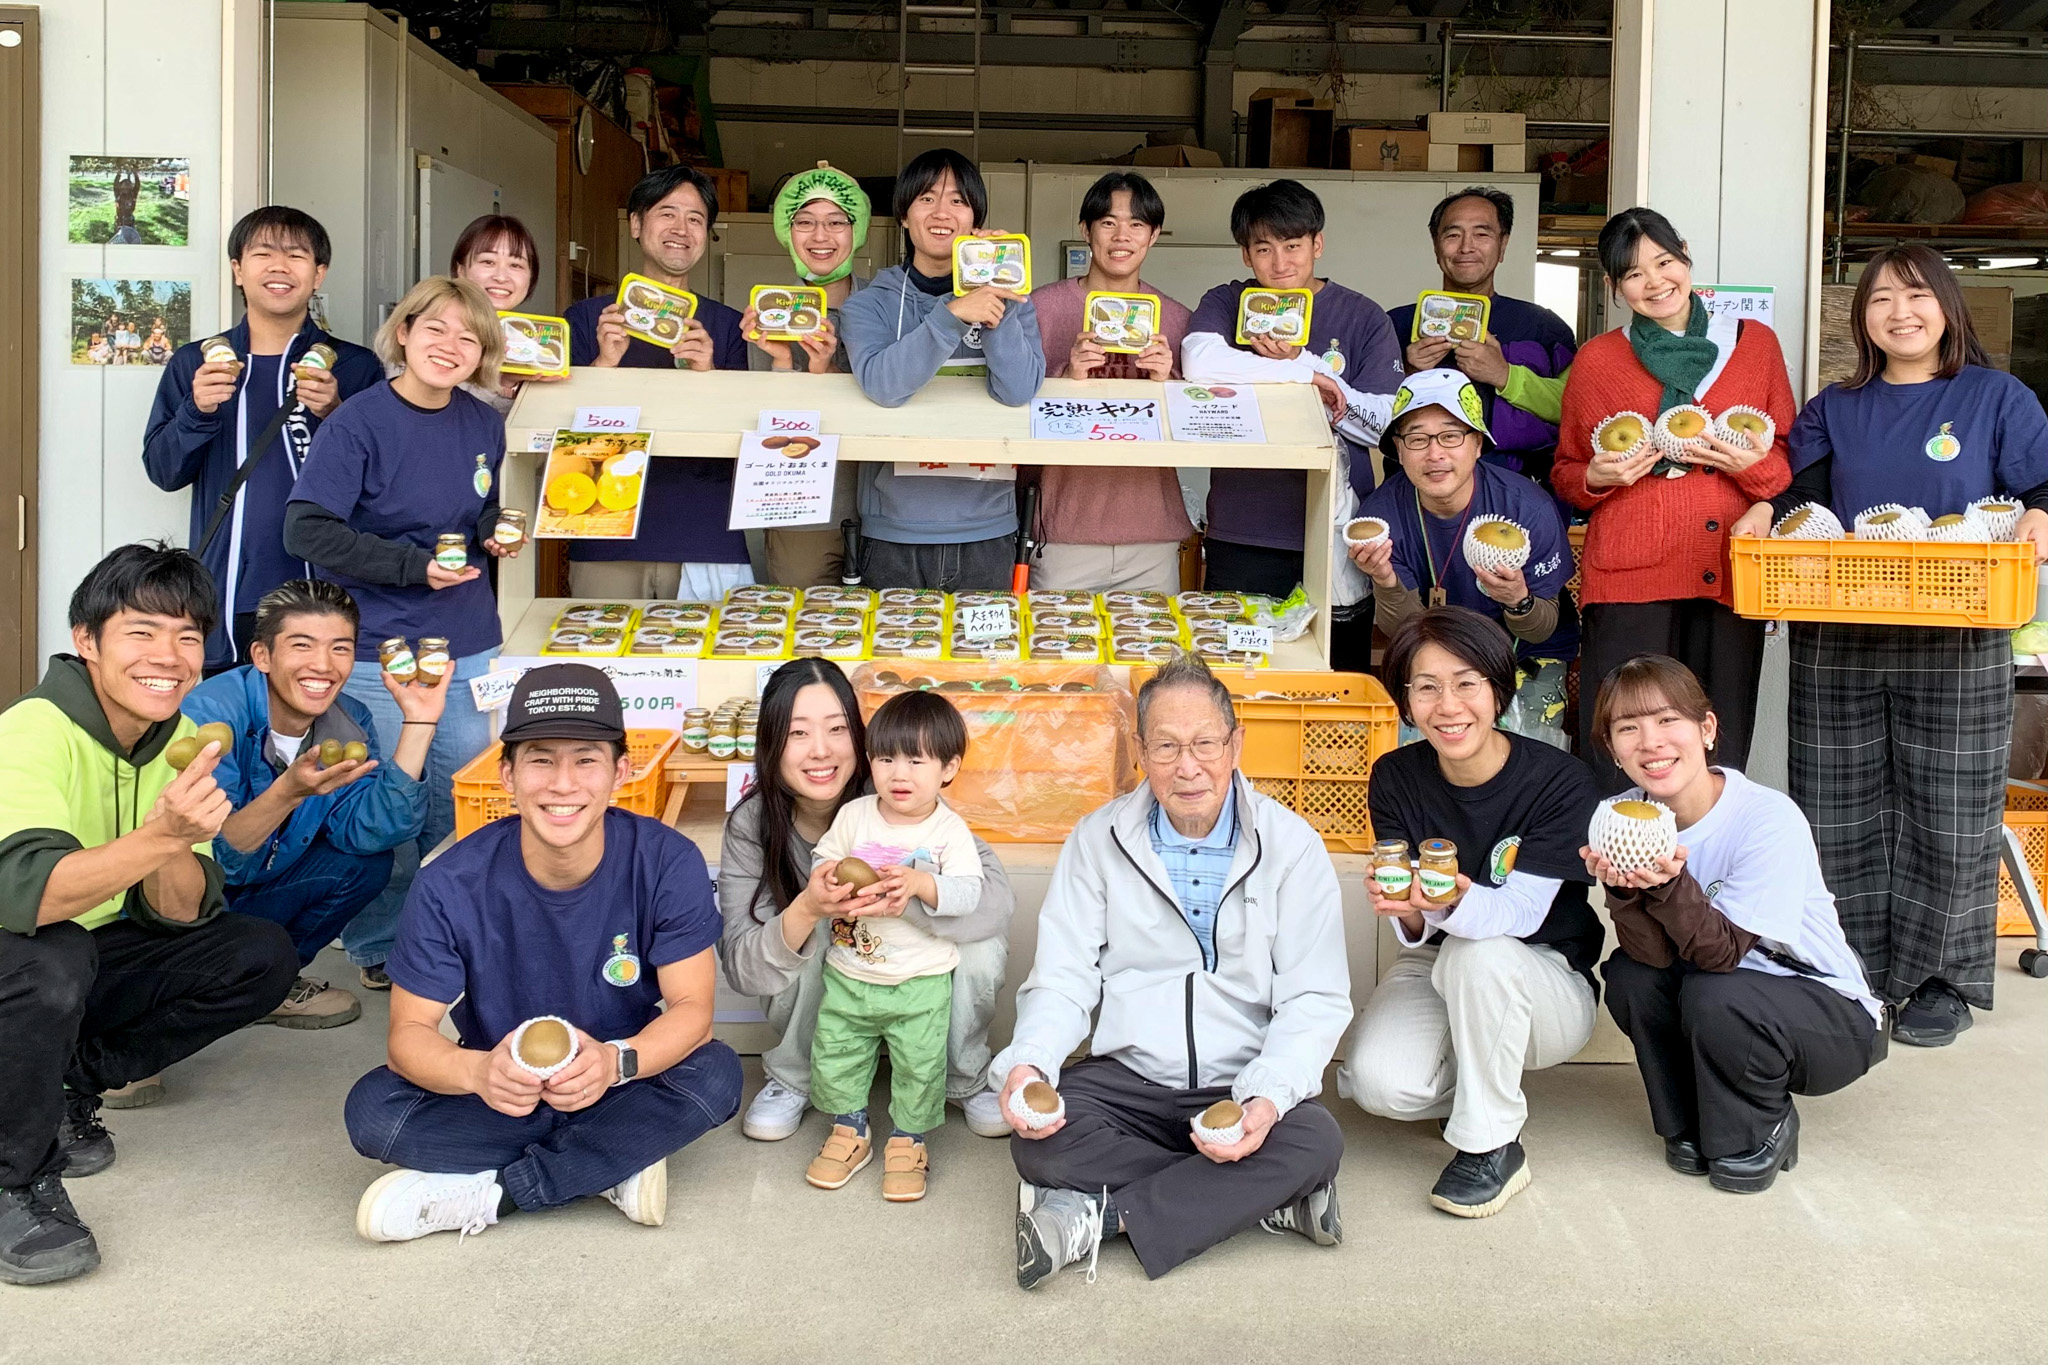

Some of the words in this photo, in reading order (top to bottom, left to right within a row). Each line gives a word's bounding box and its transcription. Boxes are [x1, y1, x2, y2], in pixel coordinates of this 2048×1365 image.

[776, 297, 816, 305] Kiwifruit
[1261, 302, 1299, 310] Kiwifruit
[644, 299, 684, 315] Kiwifruit
[1038, 402, 1155, 419] 完熟キウイ
[744, 461, 828, 469] ゴールドおおくま
[970, 621, 1006, 632] ヘイワード
[1233, 628, 1260, 637] ゴールド
[1240, 637, 1268, 646] おおくま
[524, 697, 551, 707] CRAFT
[552, 696, 573, 704] WITH
[575, 696, 600, 705] PRIDE
[528, 705, 557, 715] TOKYO
[558, 704, 596, 713] EST.1994
